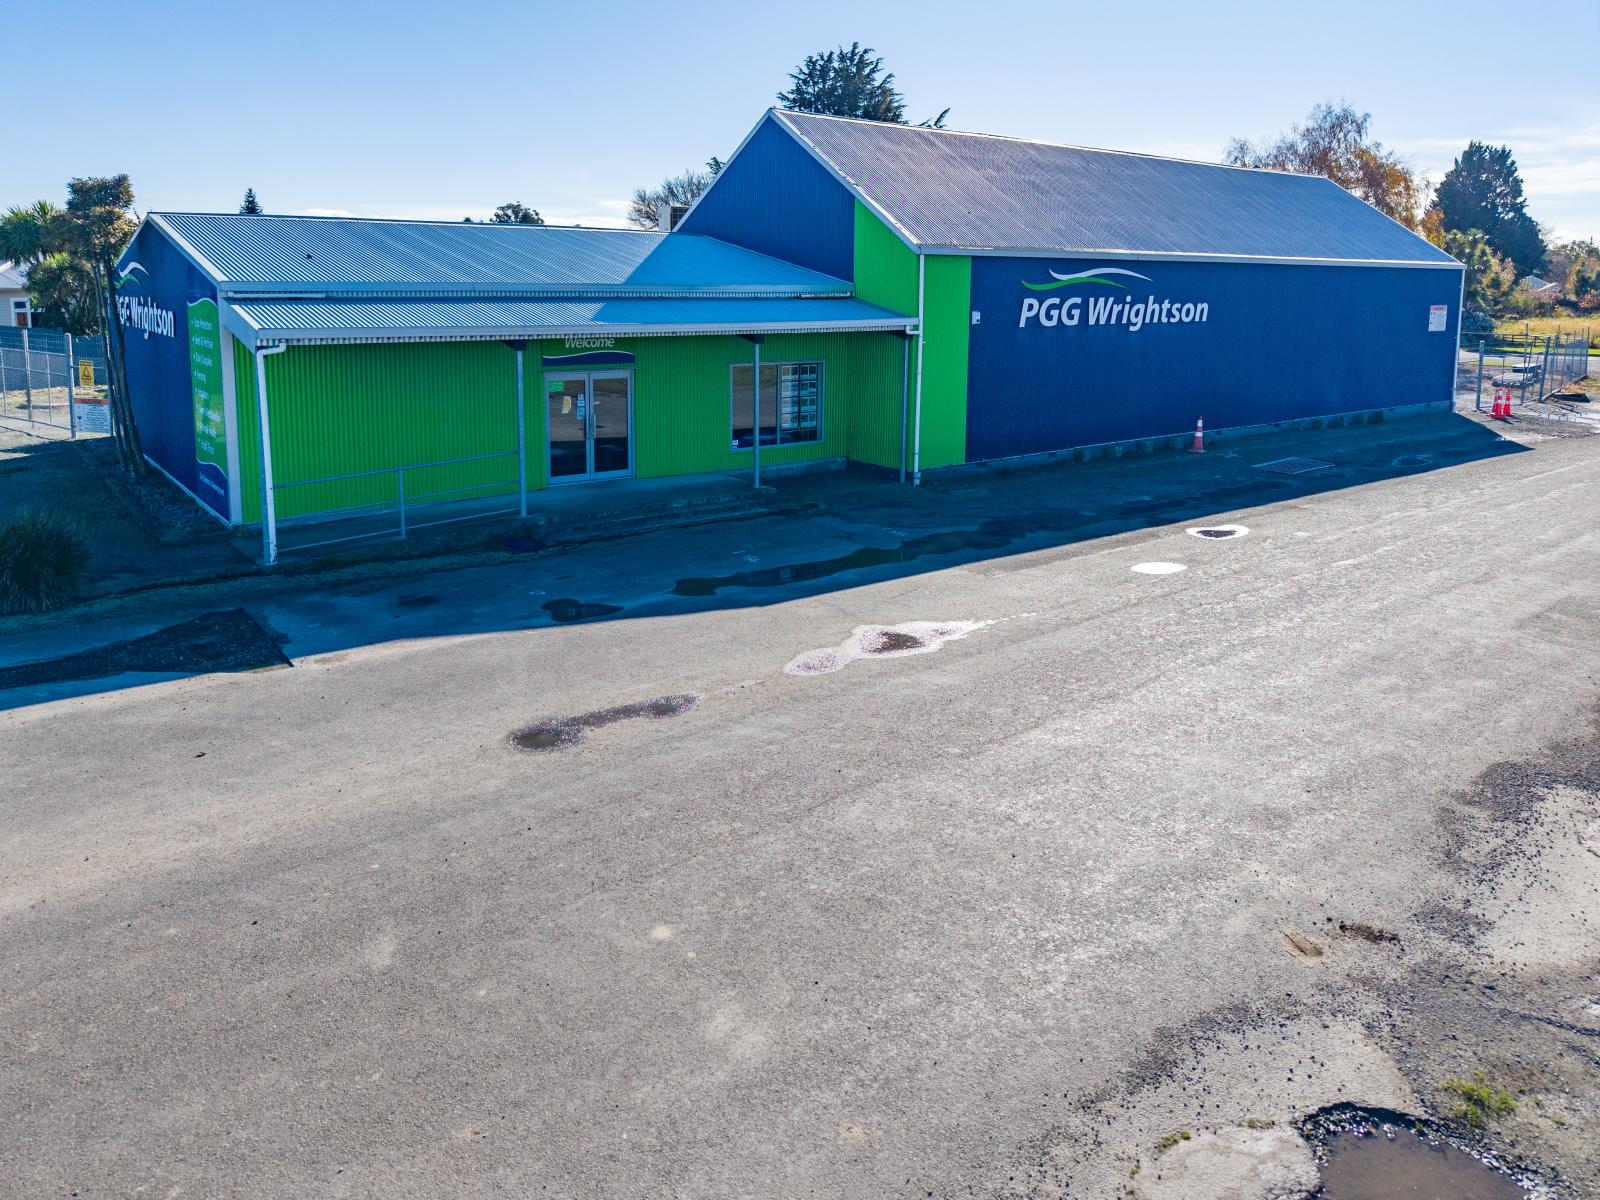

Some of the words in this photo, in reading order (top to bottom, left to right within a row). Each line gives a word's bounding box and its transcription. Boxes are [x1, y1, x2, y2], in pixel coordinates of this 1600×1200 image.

[130, 296, 175, 340] Wrightson
[1018, 297, 1082, 328] PGG
[1088, 295, 1209, 332] Wrightson
[565, 337, 615, 348] Welcome
